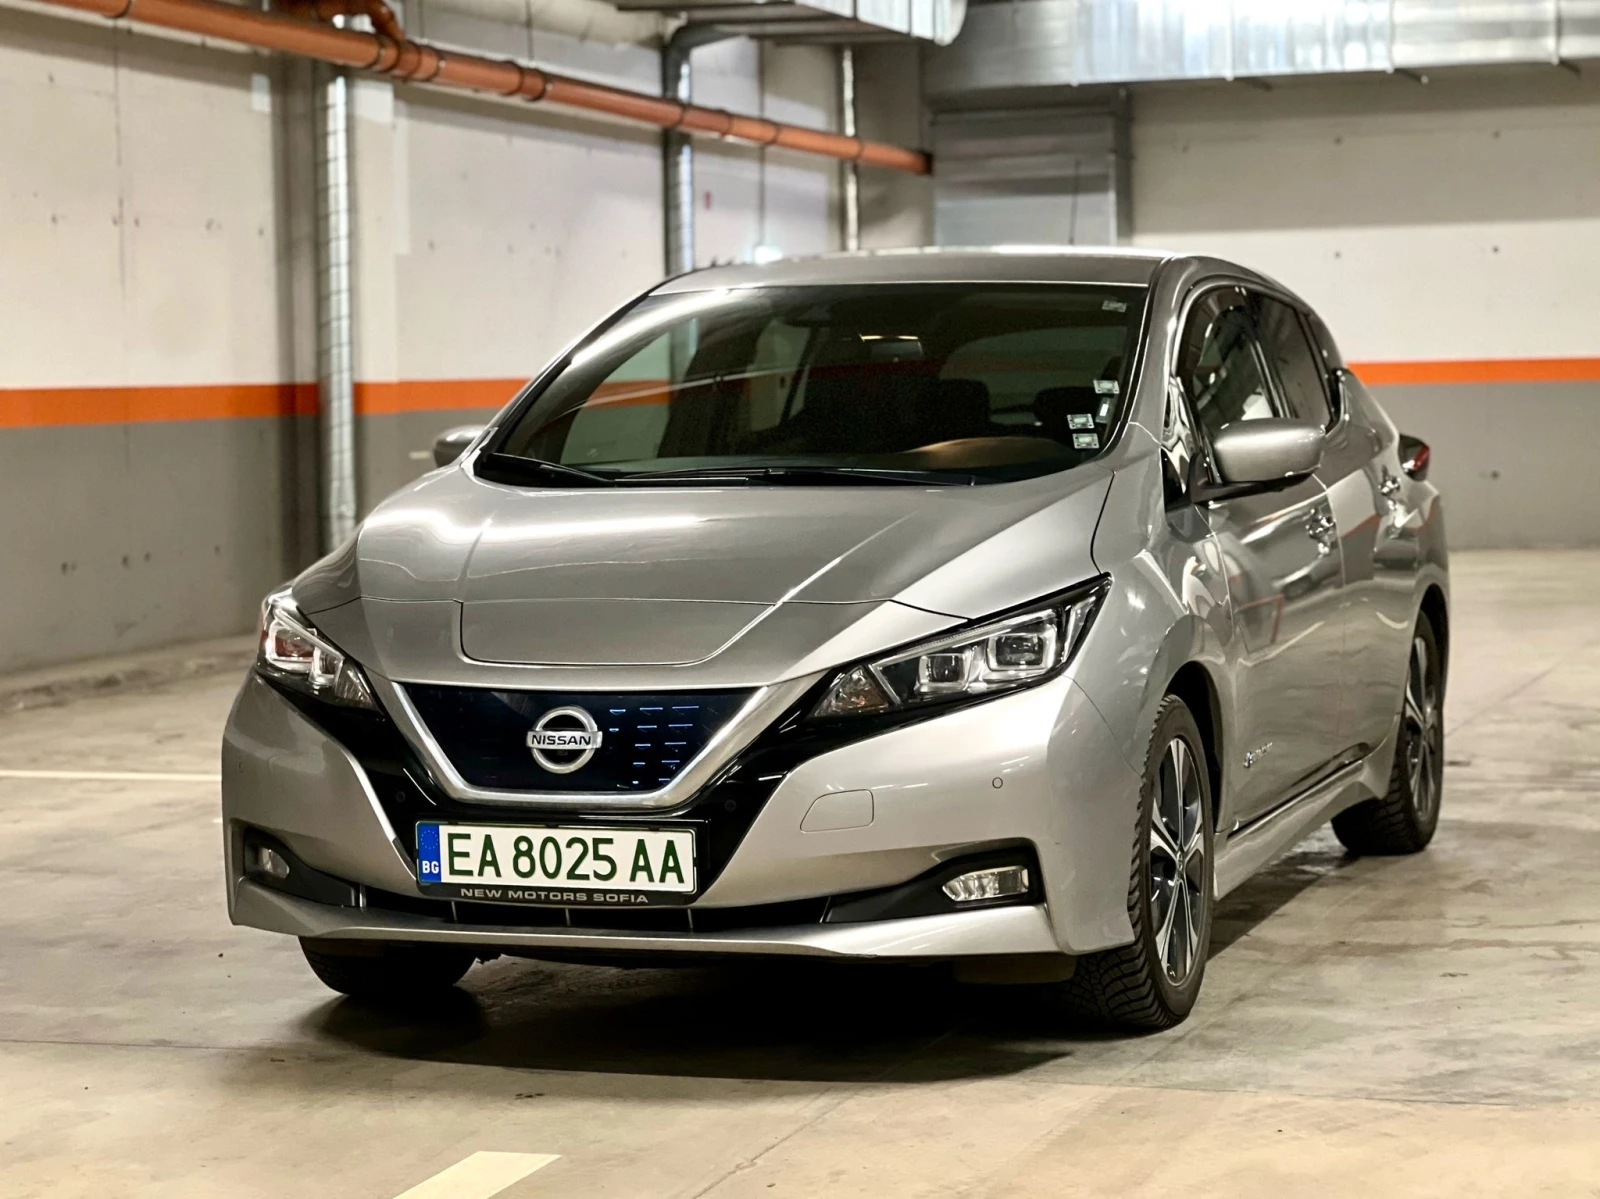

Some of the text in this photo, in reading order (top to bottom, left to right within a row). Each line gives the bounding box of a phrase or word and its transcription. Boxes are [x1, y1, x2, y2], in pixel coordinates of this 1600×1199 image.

[531, 735, 591, 746] NISSAN
[447, 832, 685, 884] EA 8025 AA
[422, 860, 440, 874] BG
[460, 888, 649, 903] NEW MOTORS SOFIA
